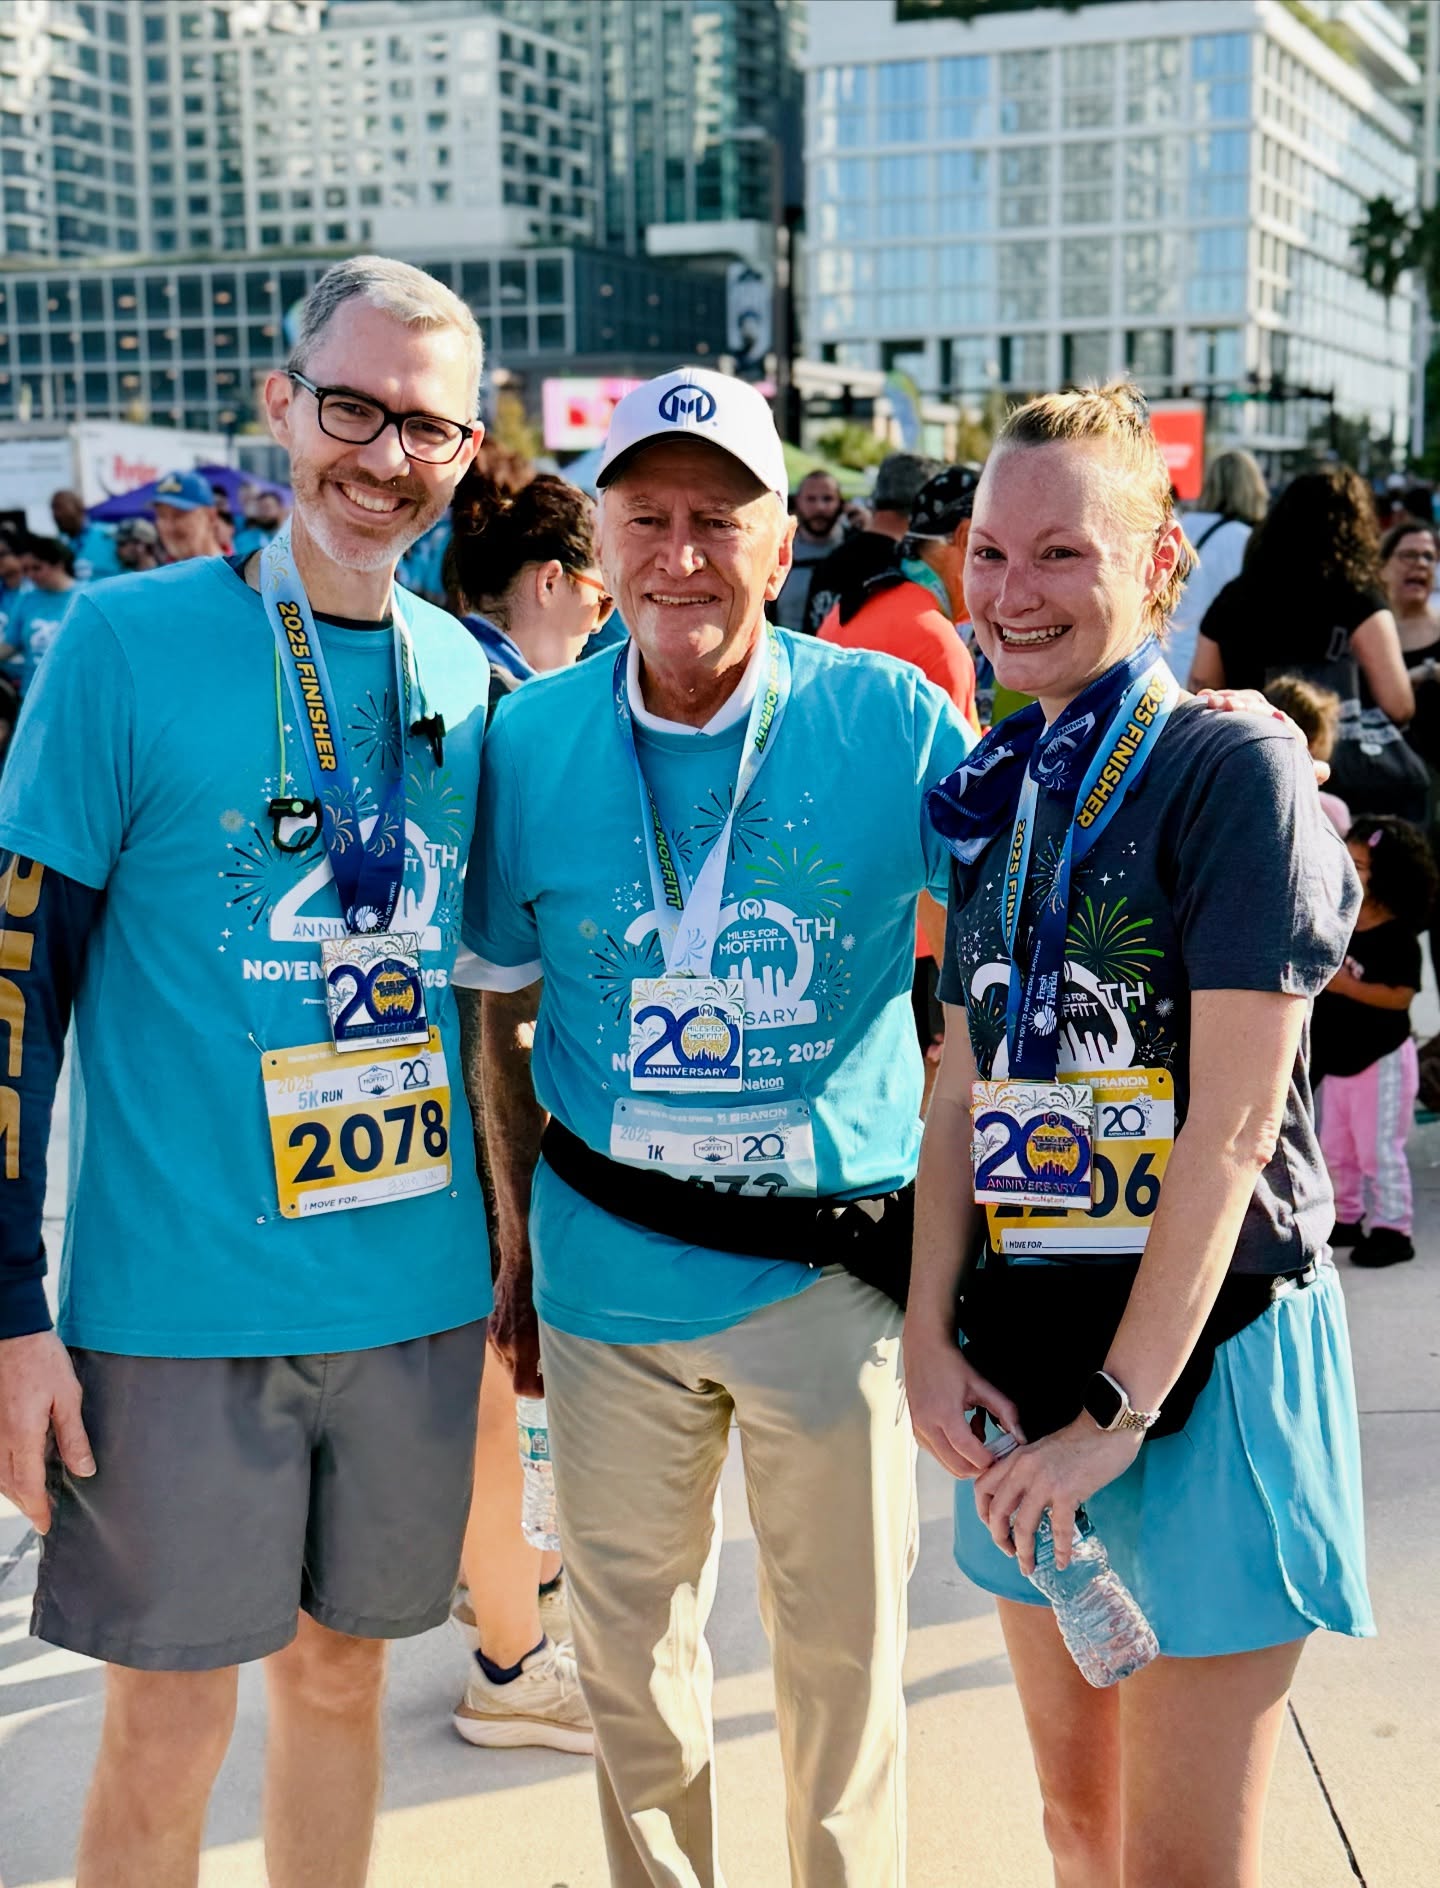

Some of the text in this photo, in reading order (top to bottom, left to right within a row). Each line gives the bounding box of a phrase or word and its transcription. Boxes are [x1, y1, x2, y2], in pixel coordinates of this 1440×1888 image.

[278, 601, 337, 771] 2025 FINISHER
[1077, 674, 1169, 829] 2025 FINISHER
[1008, 819, 1027, 875] 2025
[655, 830, 685, 911] MOFFITT
[727, 929, 779, 940] MILES FOR
[719, 938, 788, 955] MOFFITT
[1036, 974, 1047, 1000] Fresh
[1046, 971, 1060, 1006] Florida
[1015, 940, 1042, 1063] THANK YOU TO OUR MEDAL SPONSOR
[1070, 993, 1088, 1002] FOR
[1062, 1002, 1098, 1018] FFITT
[748, 1046, 783, 1068] 22,
[644, 1067, 728, 1077] ANNIVERSARY
[742, 1076, 784, 1092] Nation
[298, 1088, 343, 1110] 5K RUN
[288, 1099, 448, 1184] 2078
[648, 1144, 664, 1161] 1K
[986, 1178, 1078, 1193] ANNIVERSARY
[309, 1199, 335, 1210] MOVE
[338, 1196, 358, 1206] FOR
[1027, 1241, 1043, 1249] FOR
